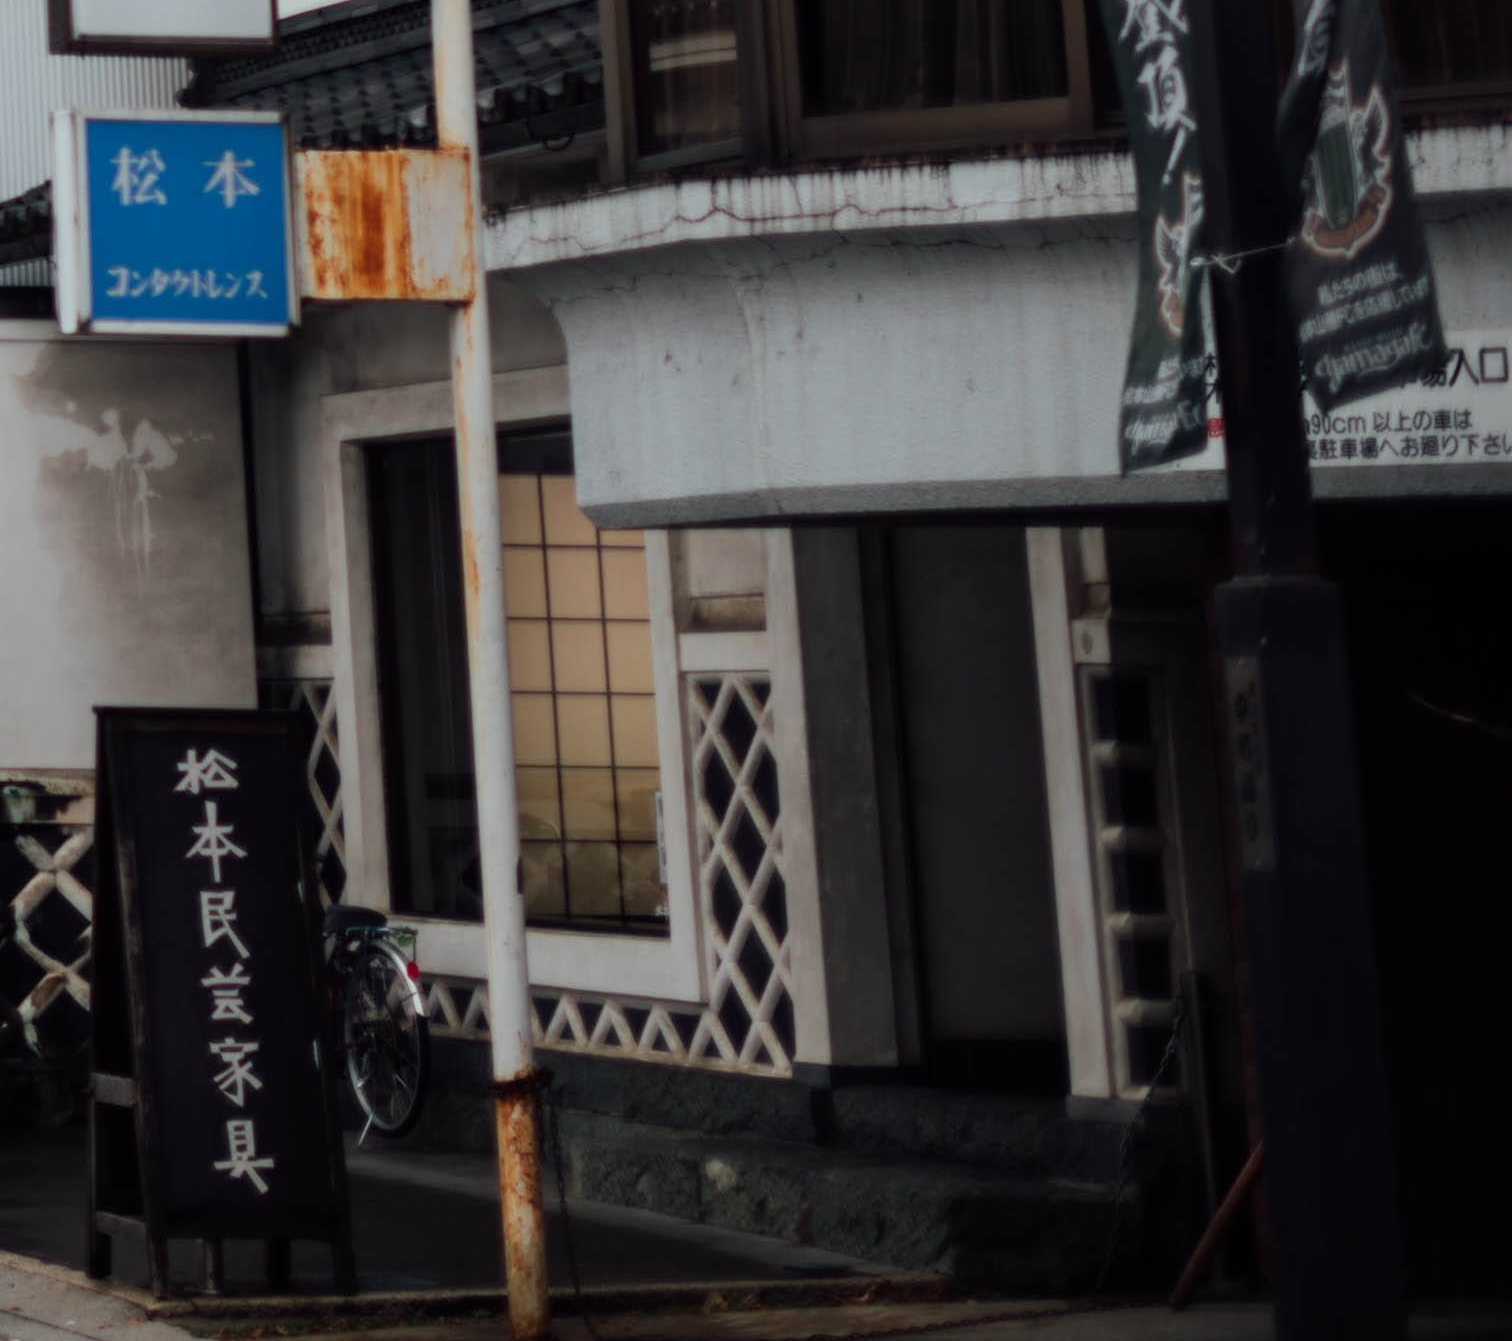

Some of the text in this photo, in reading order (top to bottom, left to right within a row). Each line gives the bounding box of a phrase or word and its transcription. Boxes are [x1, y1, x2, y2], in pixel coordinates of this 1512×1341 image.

[109, 146, 261, 209] 松本
[1372, 410, 1473, 433] 以上の車は
[172, 747, 275, 1195] 松本民芸家具
